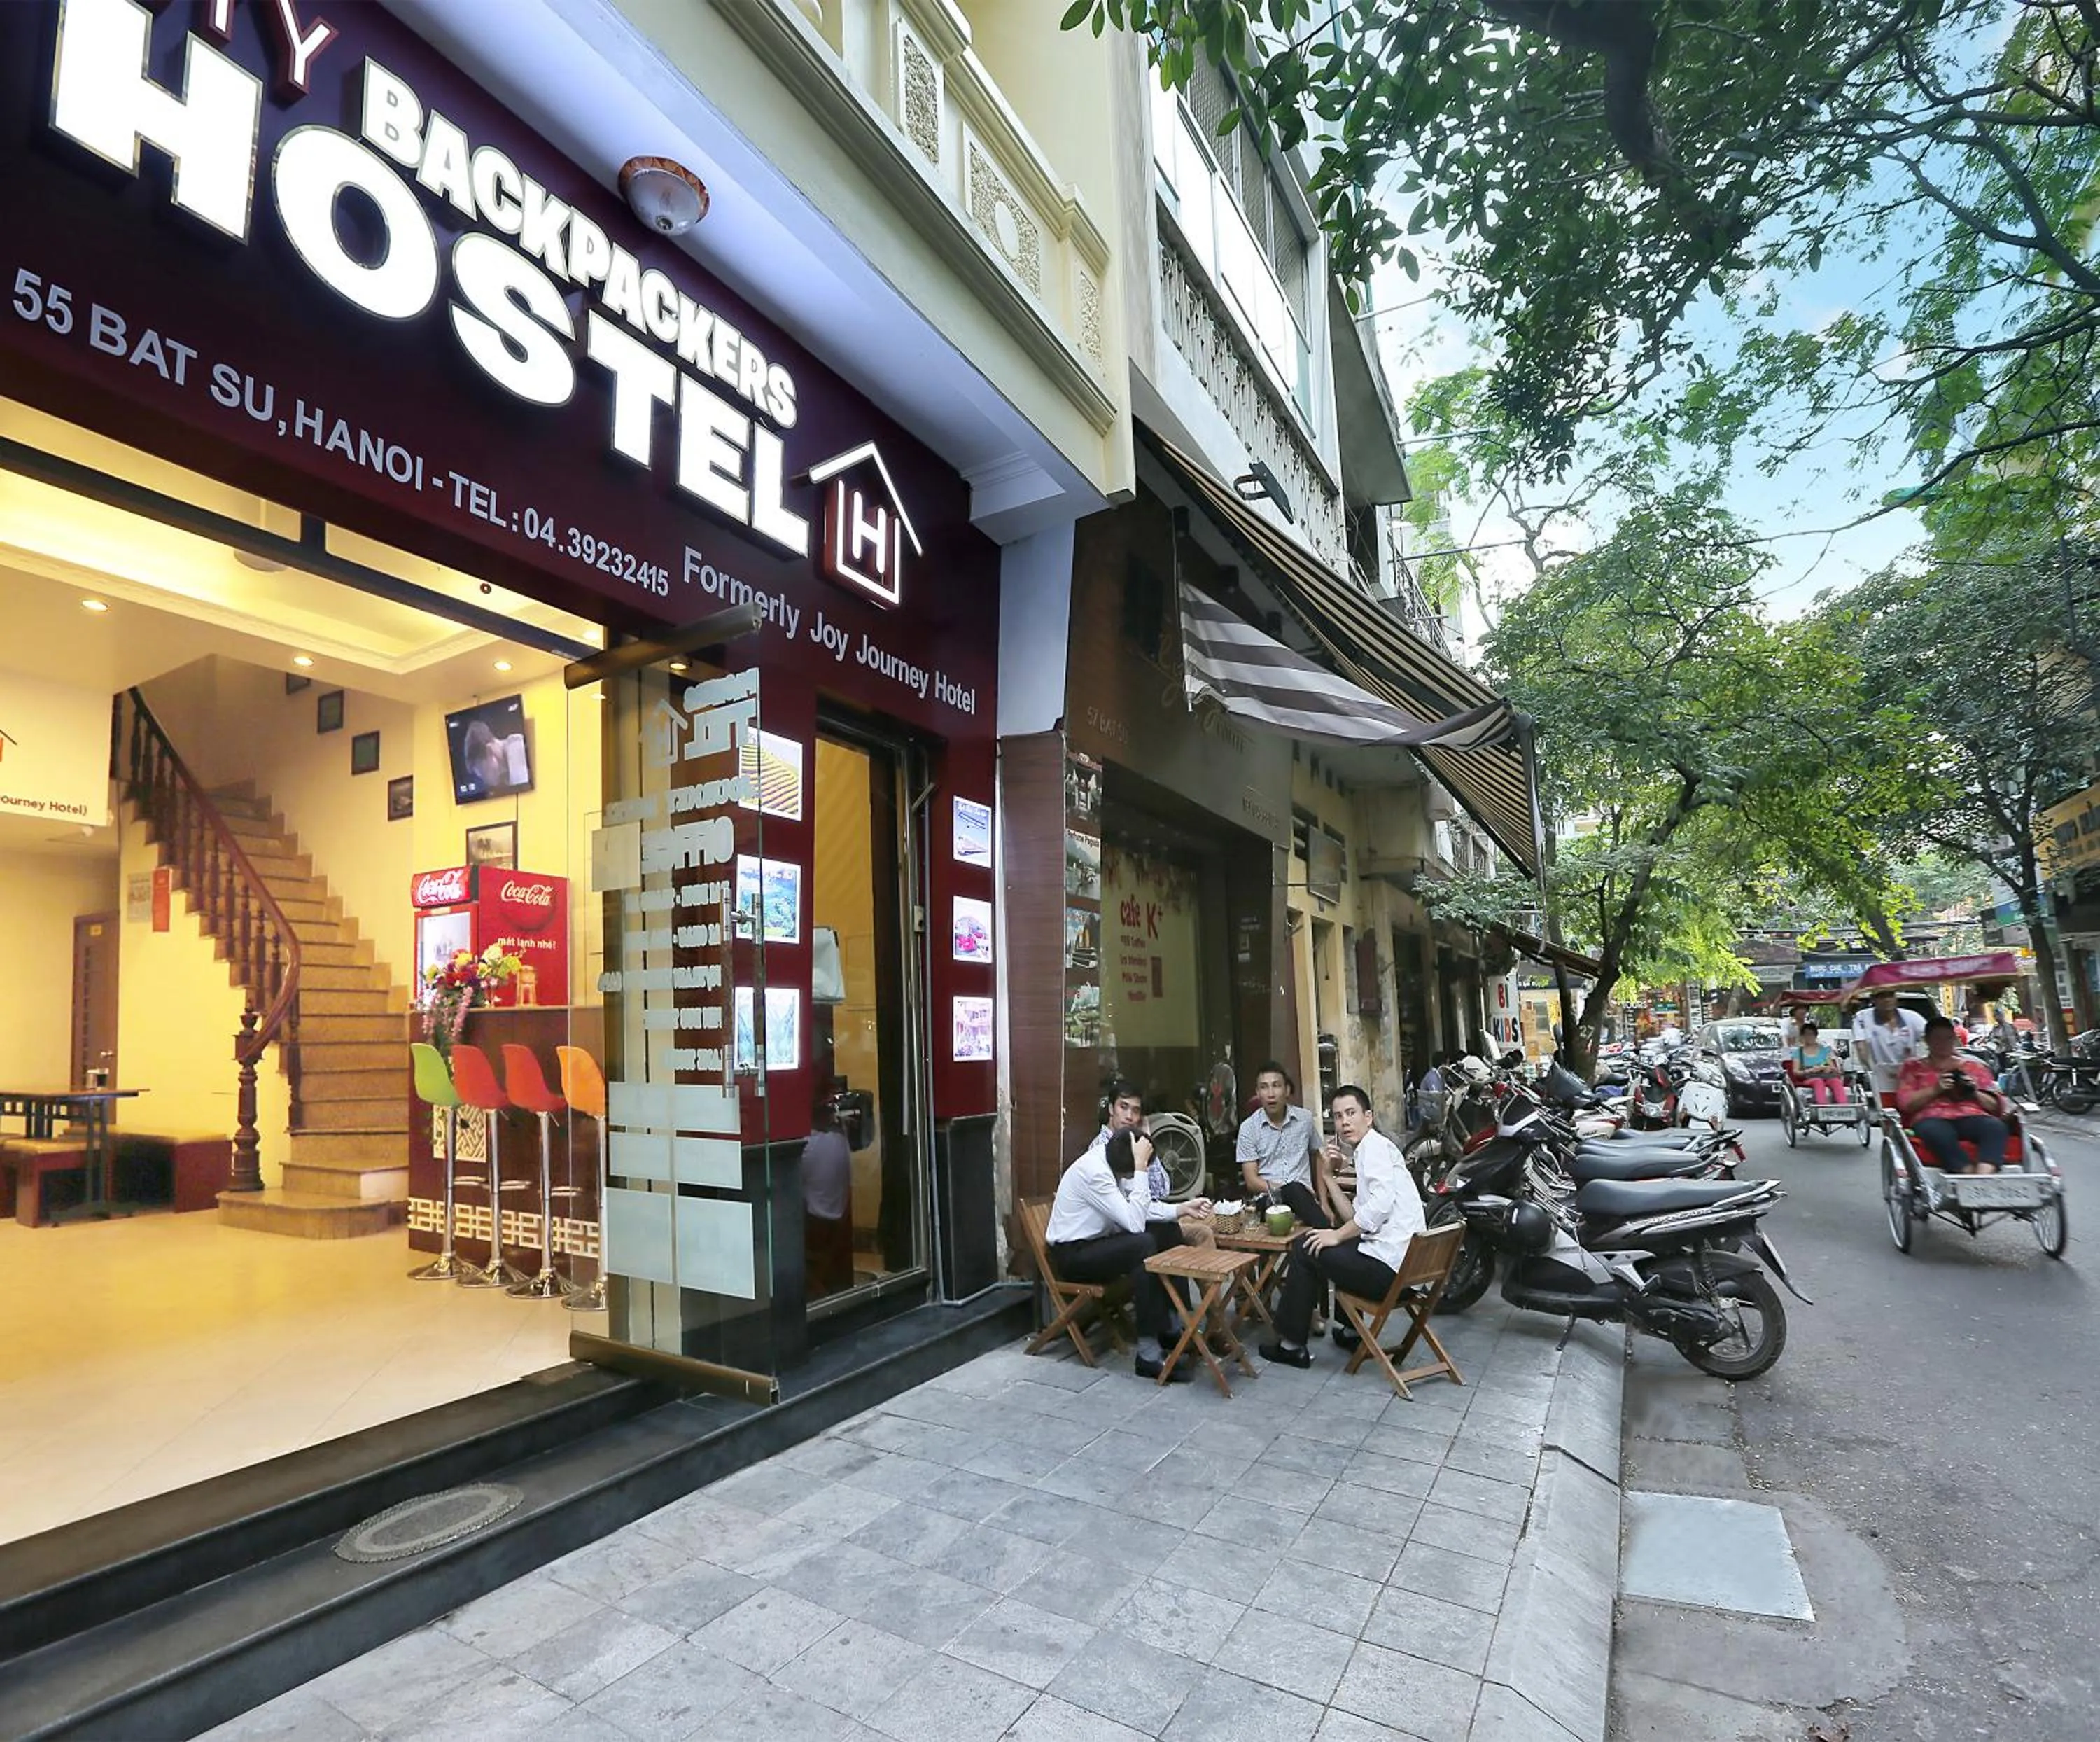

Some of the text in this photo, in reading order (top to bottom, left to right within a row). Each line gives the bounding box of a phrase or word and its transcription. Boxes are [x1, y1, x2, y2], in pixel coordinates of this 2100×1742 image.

[49, 0, 810, 559] HOSTEL
[361, 55, 797, 428] BACKPACKERS
[13, 268, 74, 335] 55
[89, 303, 198, 386] BAT
[683, 545, 975, 715] Formerly Joy Journey Hotel
[0, 795, 88, 817] ourney Hotel)
[1492, 1017, 1518, 1043] KIDS
[1579, 1025, 1595, 1039] 27
